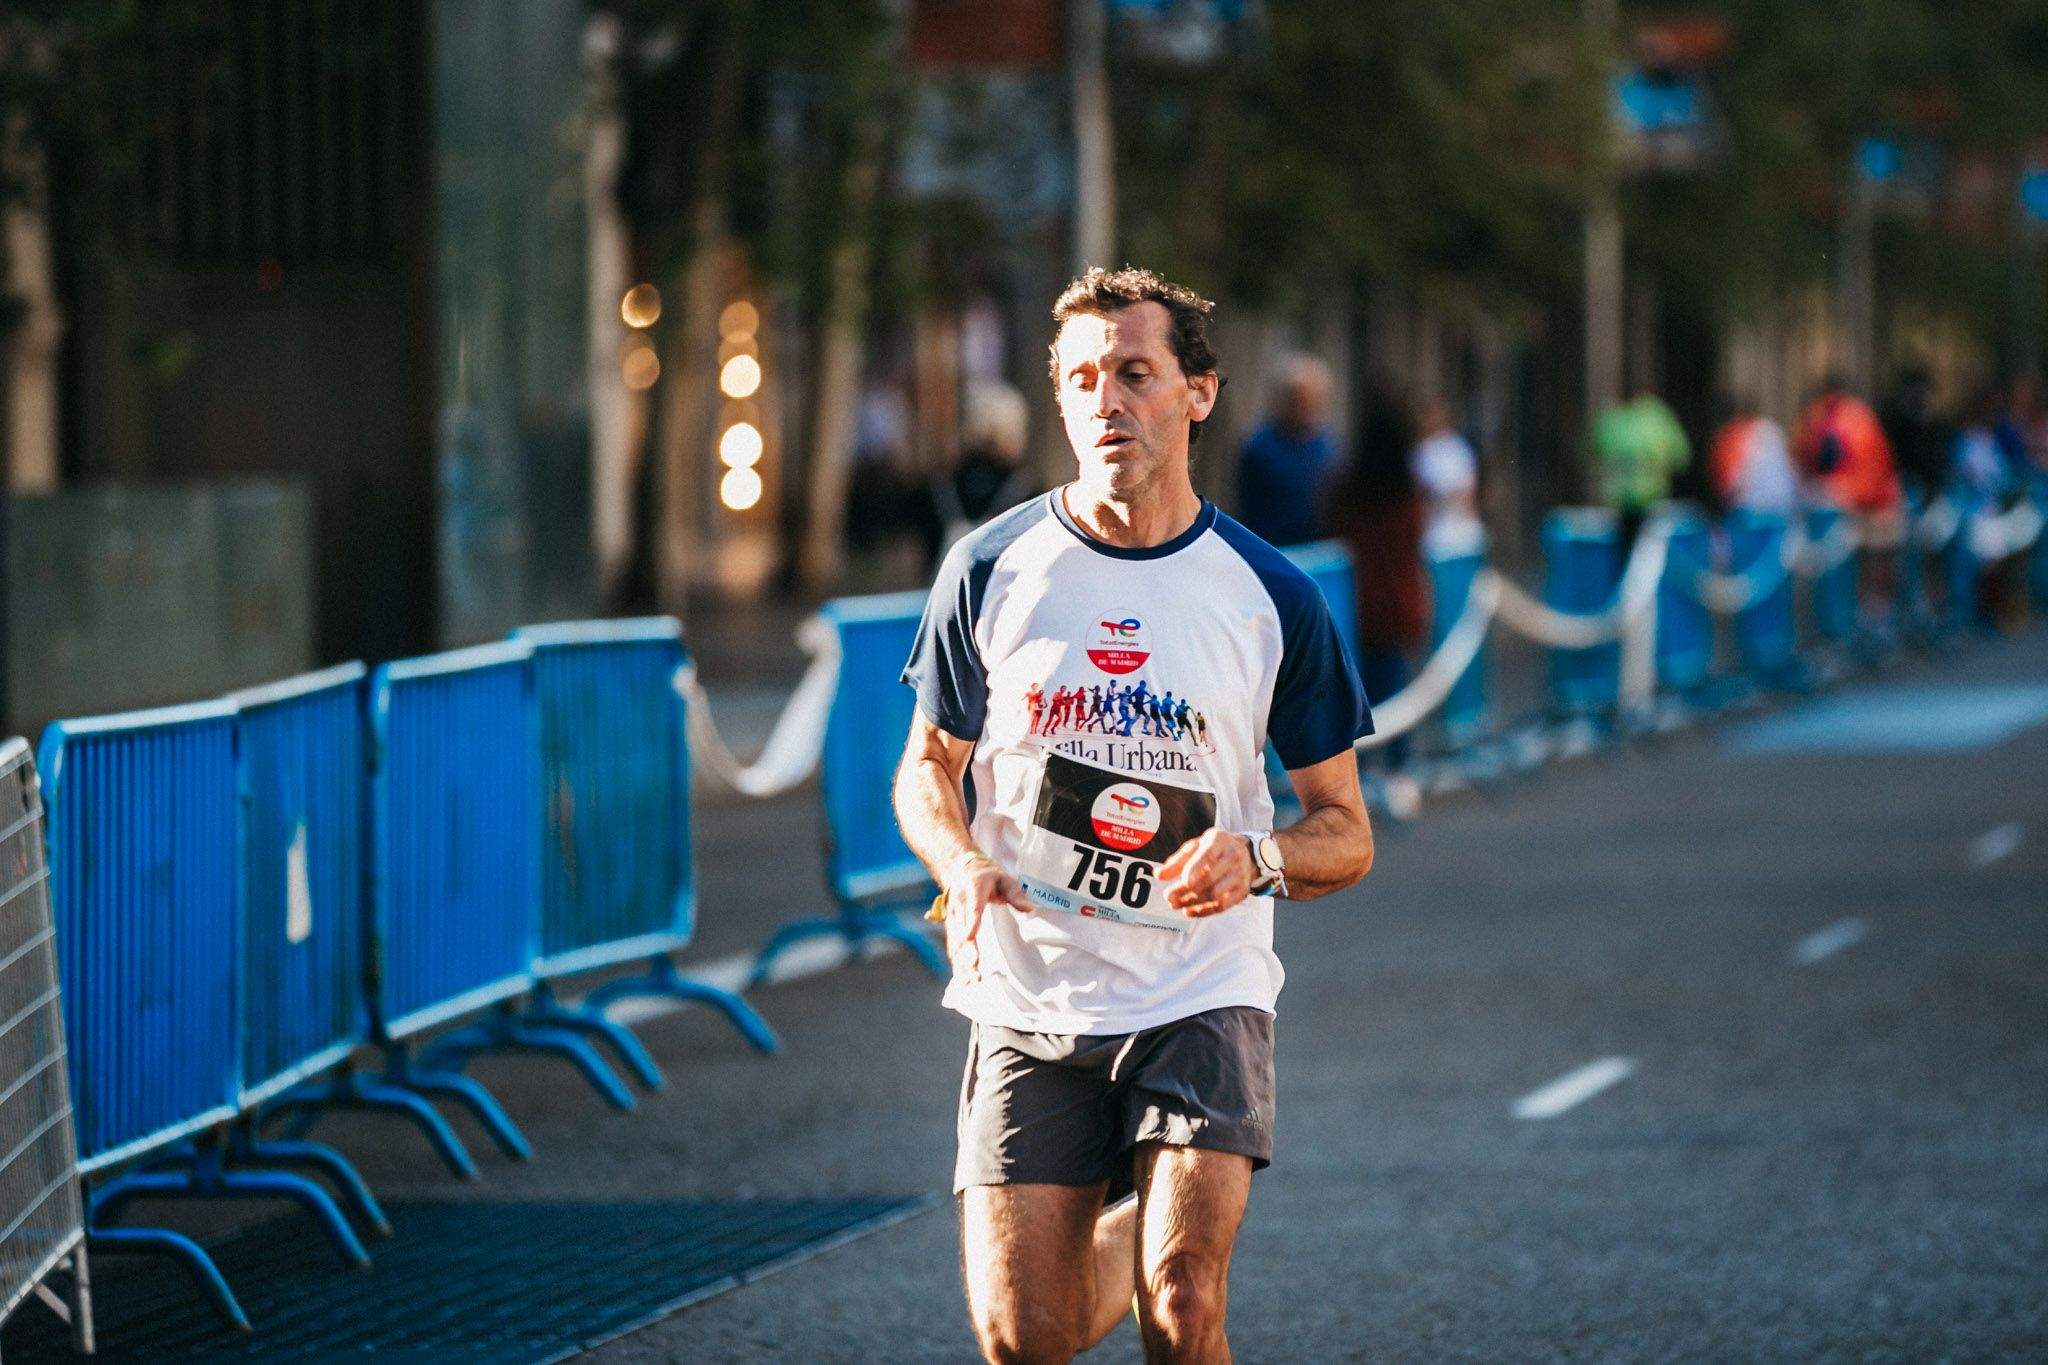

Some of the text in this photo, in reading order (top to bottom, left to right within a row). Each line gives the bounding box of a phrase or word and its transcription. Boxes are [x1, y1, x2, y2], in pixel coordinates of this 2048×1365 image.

[1106, 741, 1198, 771] Urbana
[1111, 825, 1135, 836] MILLA
[1112, 832, 1142, 845] MADRID
[1067, 843, 1154, 909] 756
[1032, 888, 1071, 909] MADRID
